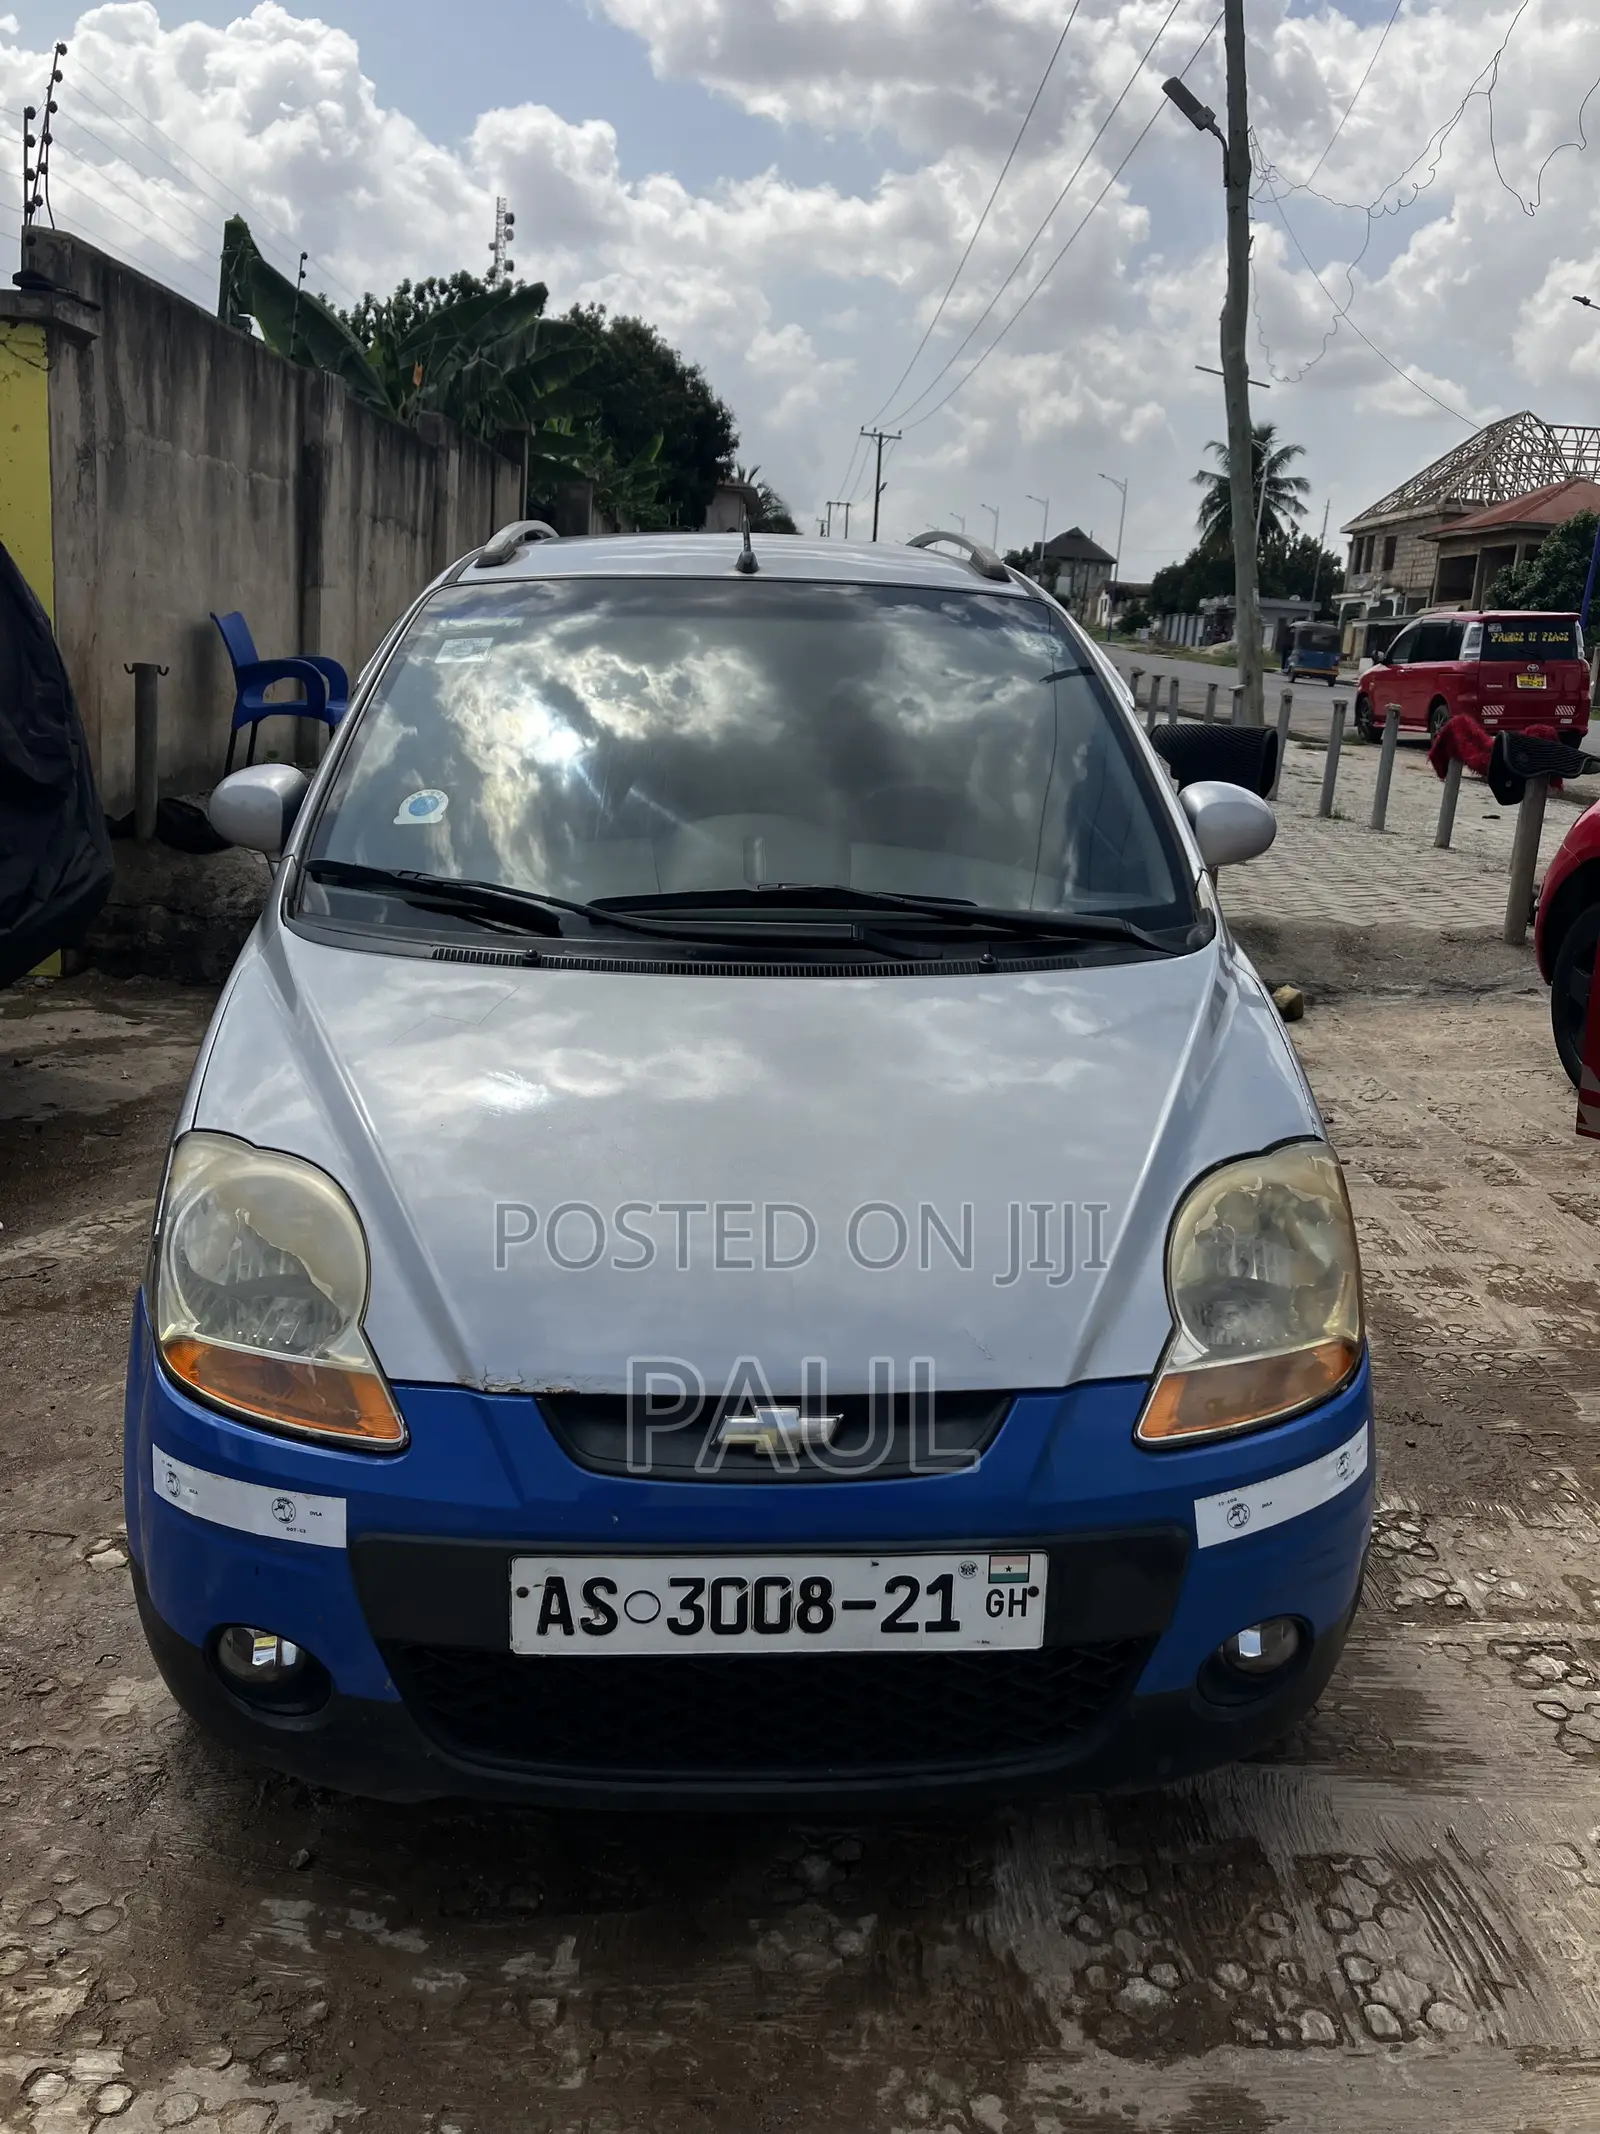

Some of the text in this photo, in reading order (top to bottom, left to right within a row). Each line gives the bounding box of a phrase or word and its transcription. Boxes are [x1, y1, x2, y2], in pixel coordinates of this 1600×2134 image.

[1542, 632, 1569, 642] PEACE
[537, 1573, 960, 1637] AS 3008-21
[986, 1588, 1027, 1618] GH
